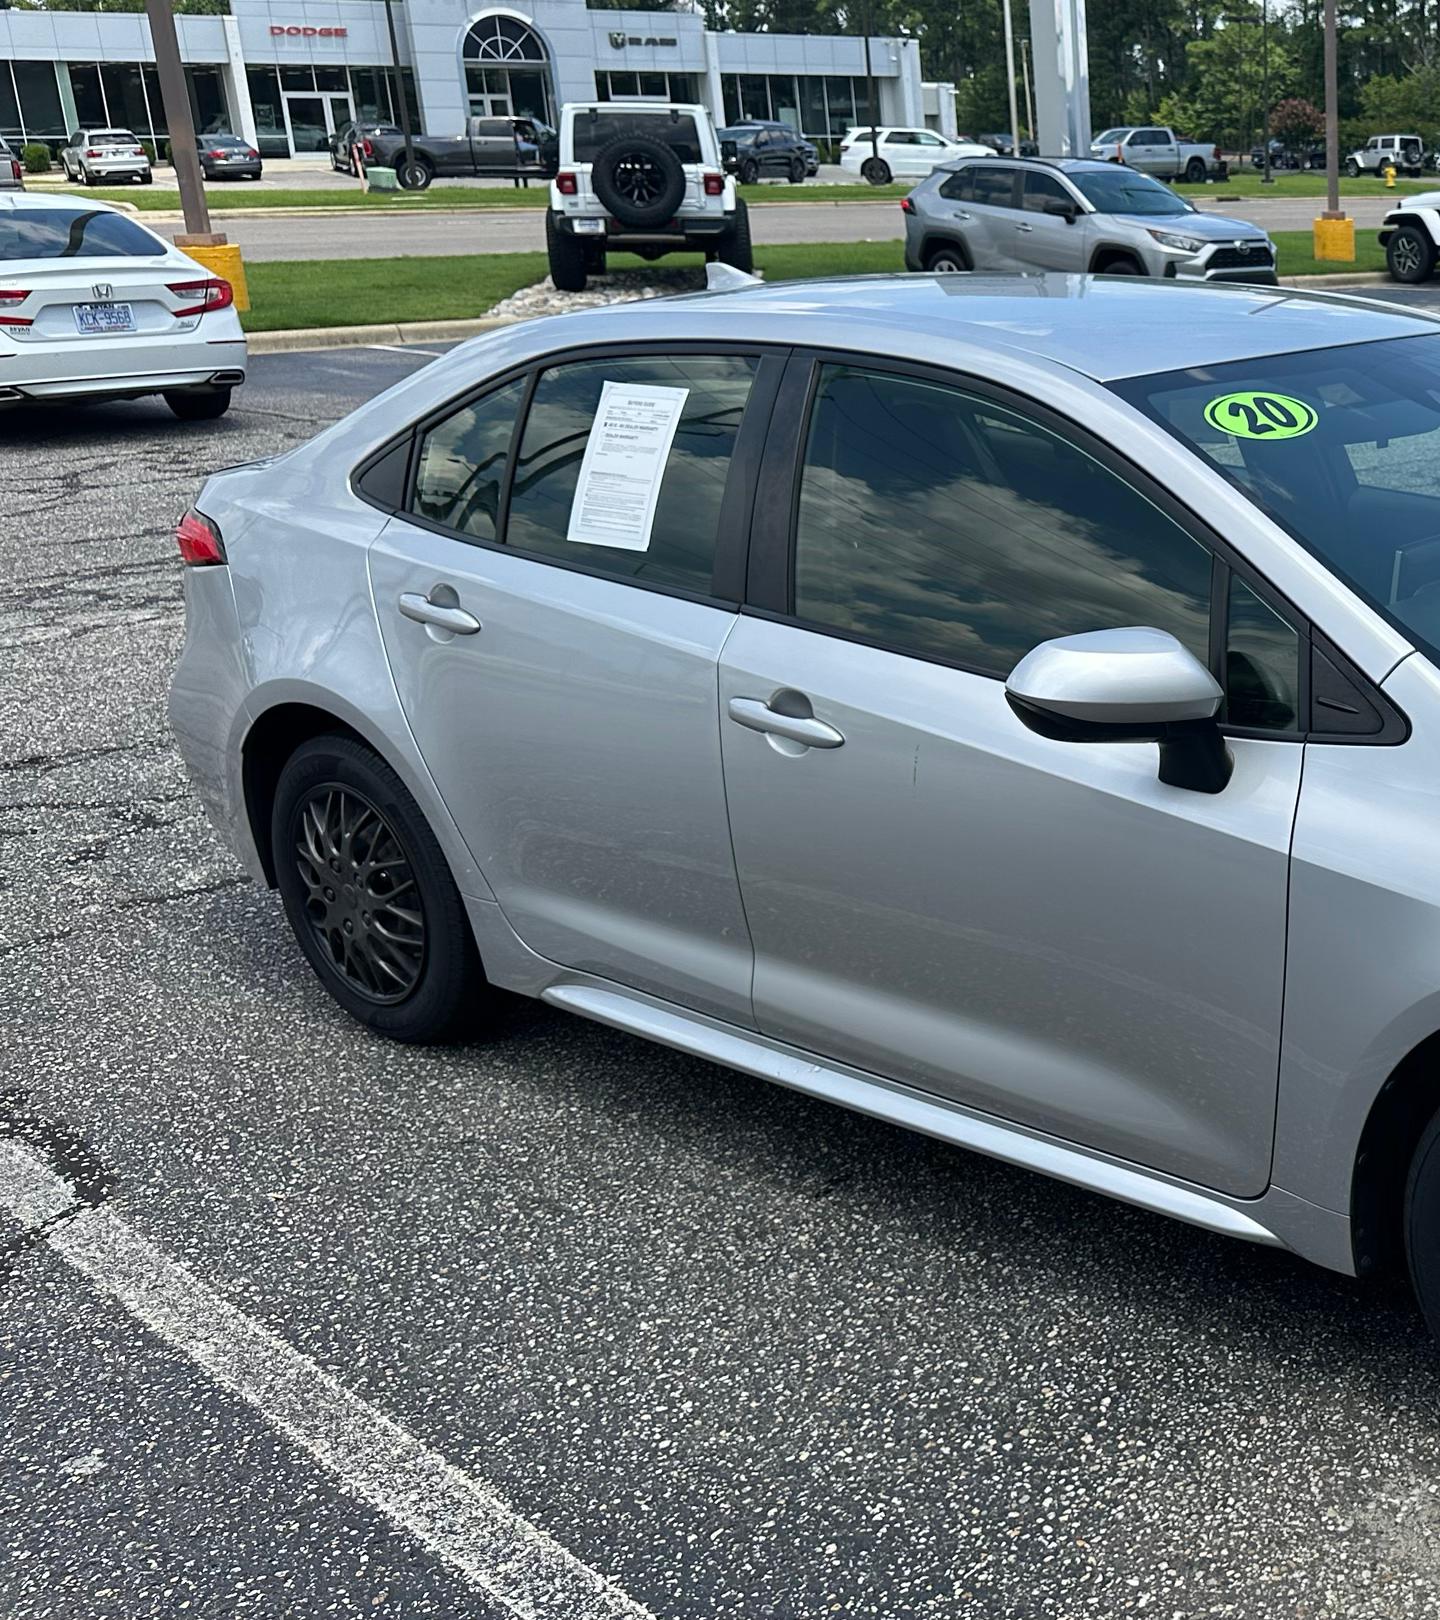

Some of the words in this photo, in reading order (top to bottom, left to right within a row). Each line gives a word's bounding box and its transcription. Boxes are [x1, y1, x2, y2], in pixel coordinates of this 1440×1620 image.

[271, 27, 347, 36] DODGE
[628, 37, 677, 46] RAM
[1229, 397, 1298, 435] 20
